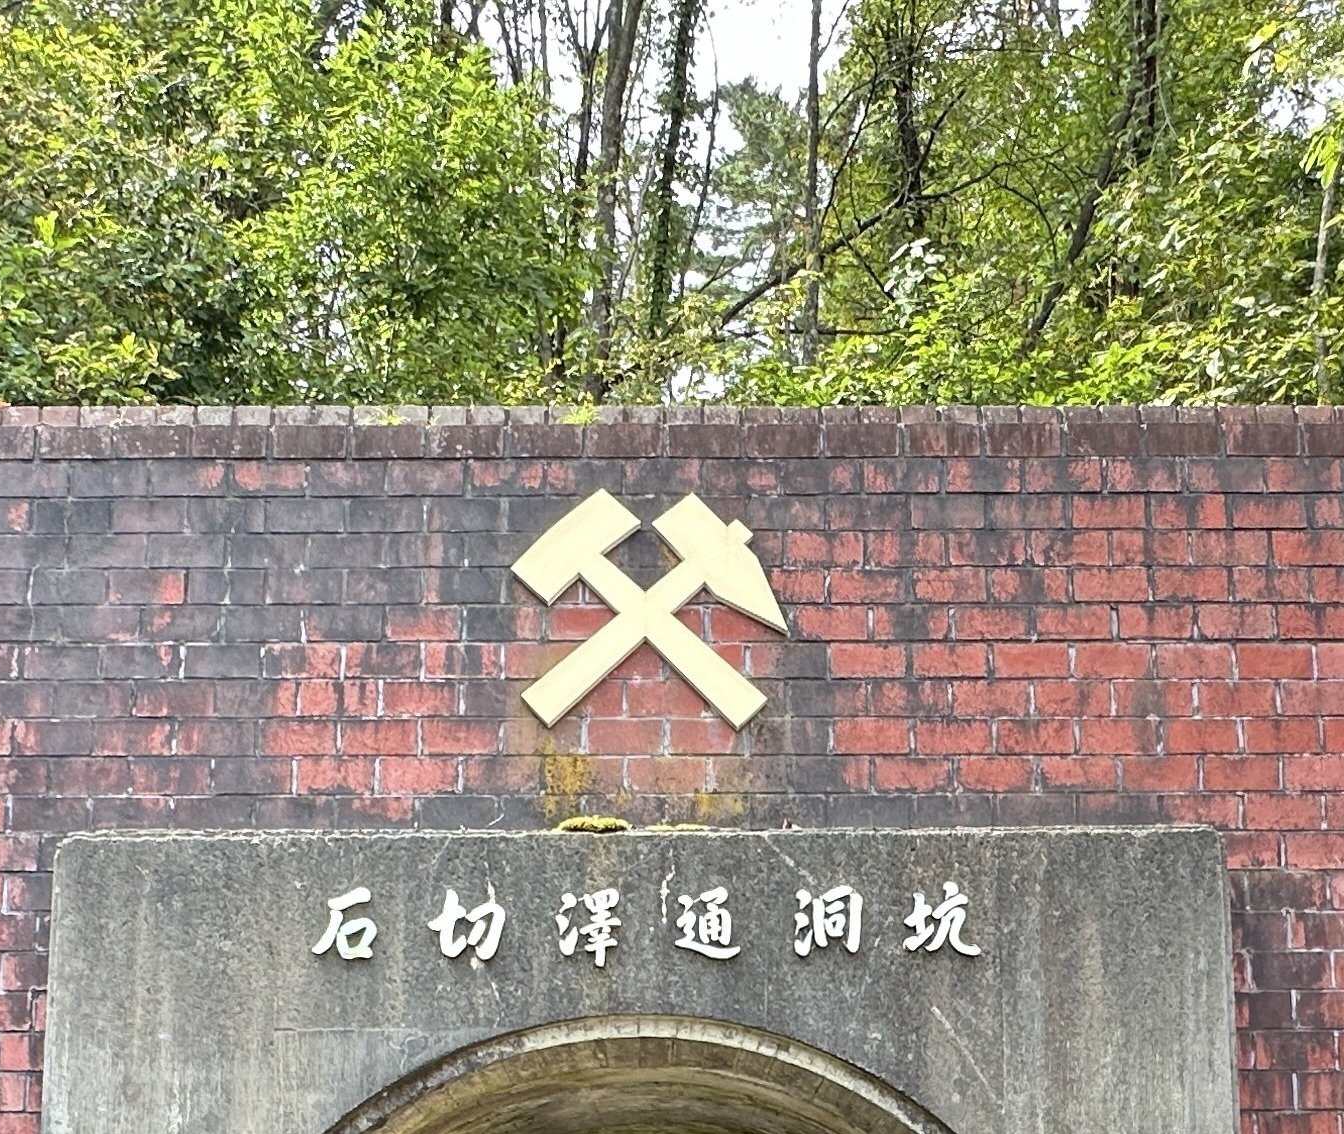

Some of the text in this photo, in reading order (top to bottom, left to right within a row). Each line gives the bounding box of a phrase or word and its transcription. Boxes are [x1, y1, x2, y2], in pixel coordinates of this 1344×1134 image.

[312, 882, 981, 967] 石切澤通洞坑
